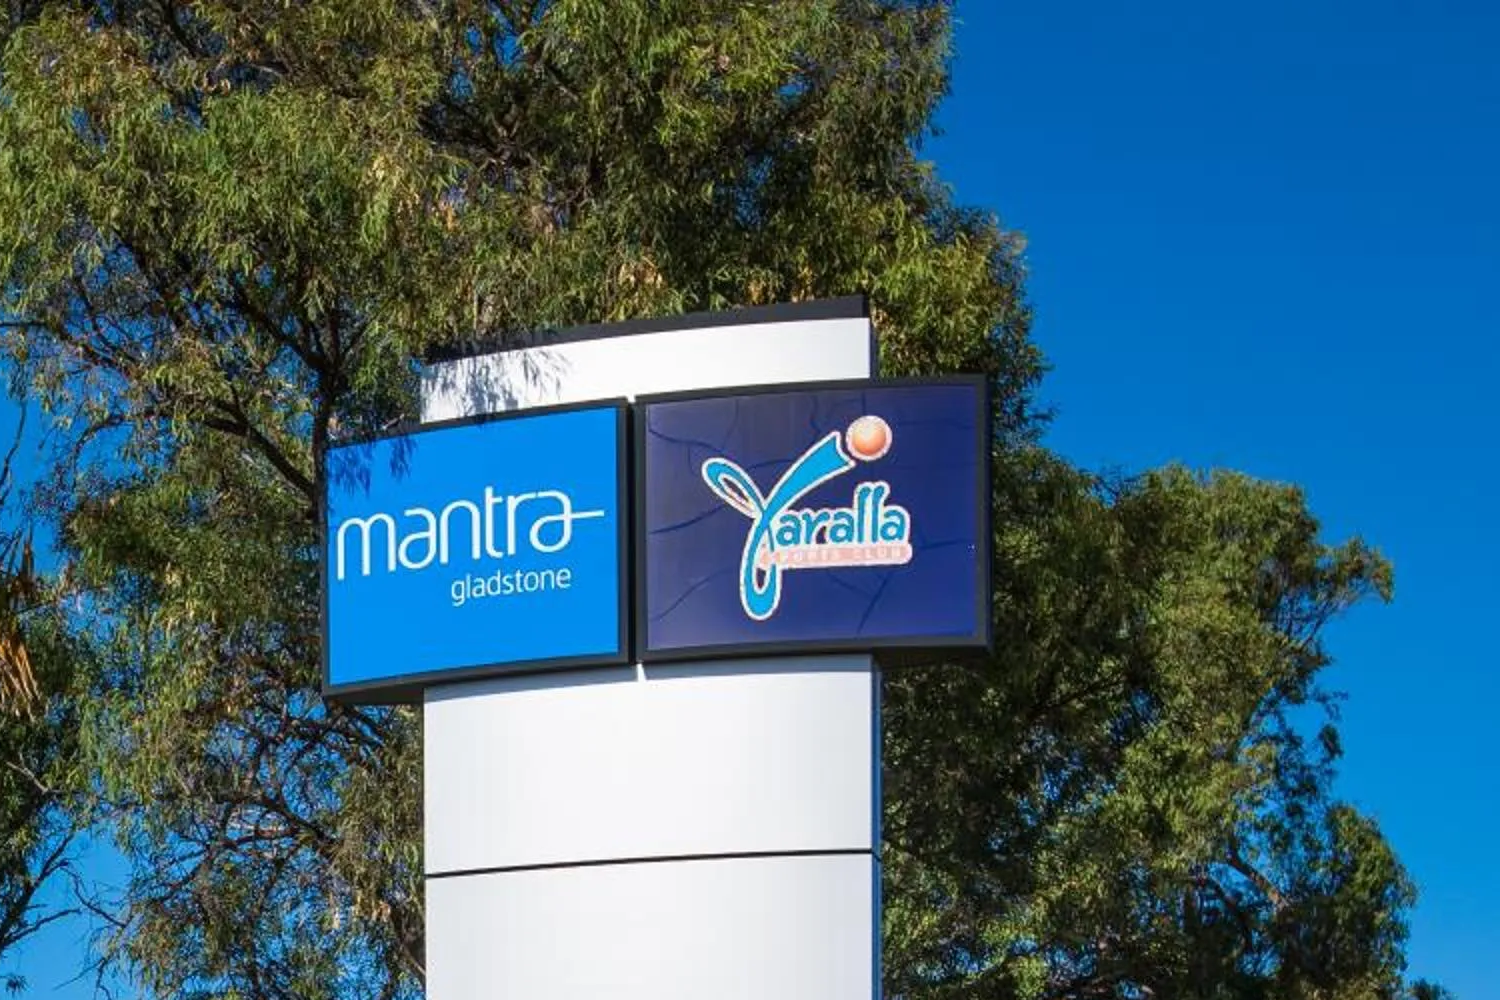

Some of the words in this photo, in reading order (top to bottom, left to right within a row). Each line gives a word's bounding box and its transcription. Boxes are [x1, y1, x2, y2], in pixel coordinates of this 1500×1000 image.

[337, 486, 605, 581] mantra
[702, 430, 911, 621] Yaralla
[451, 568, 571, 606] gladstone
